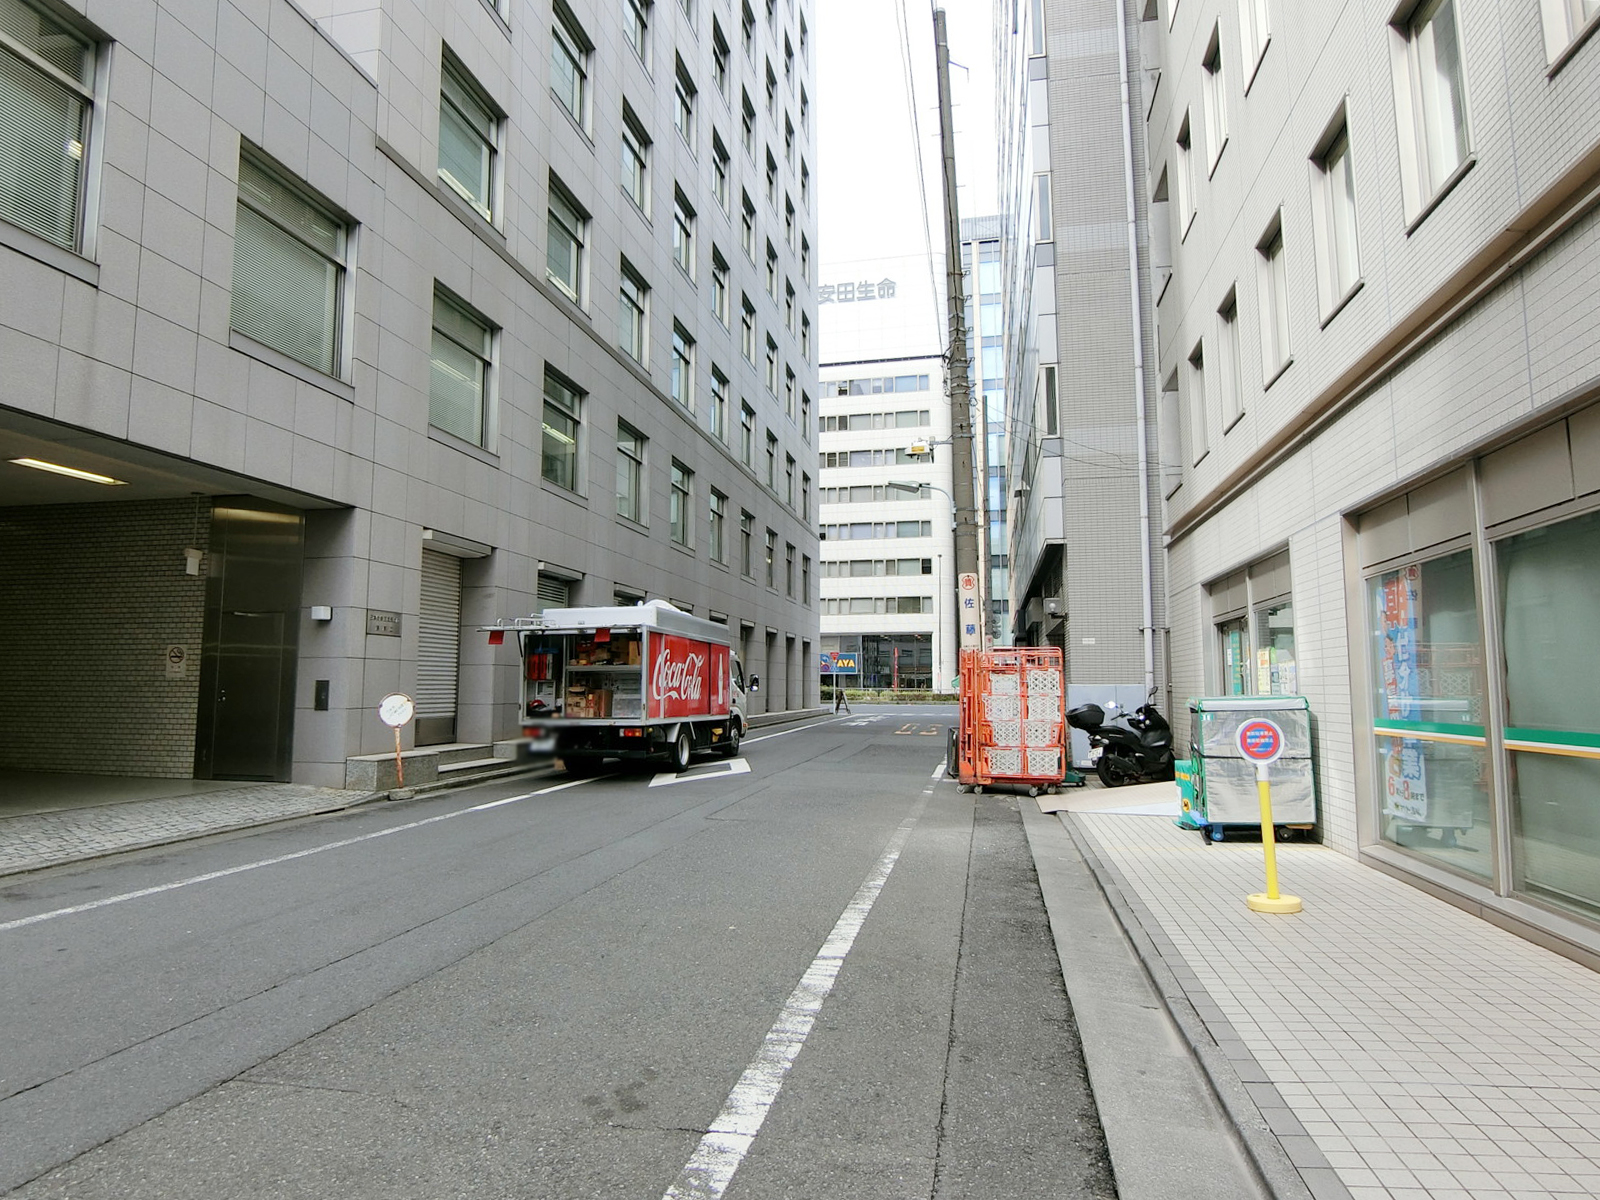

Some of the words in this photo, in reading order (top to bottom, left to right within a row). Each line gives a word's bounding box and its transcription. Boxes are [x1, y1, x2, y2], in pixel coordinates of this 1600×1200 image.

[818, 277, 897, 304] 安田生命
[964, 597, 976, 635] 佐藤
